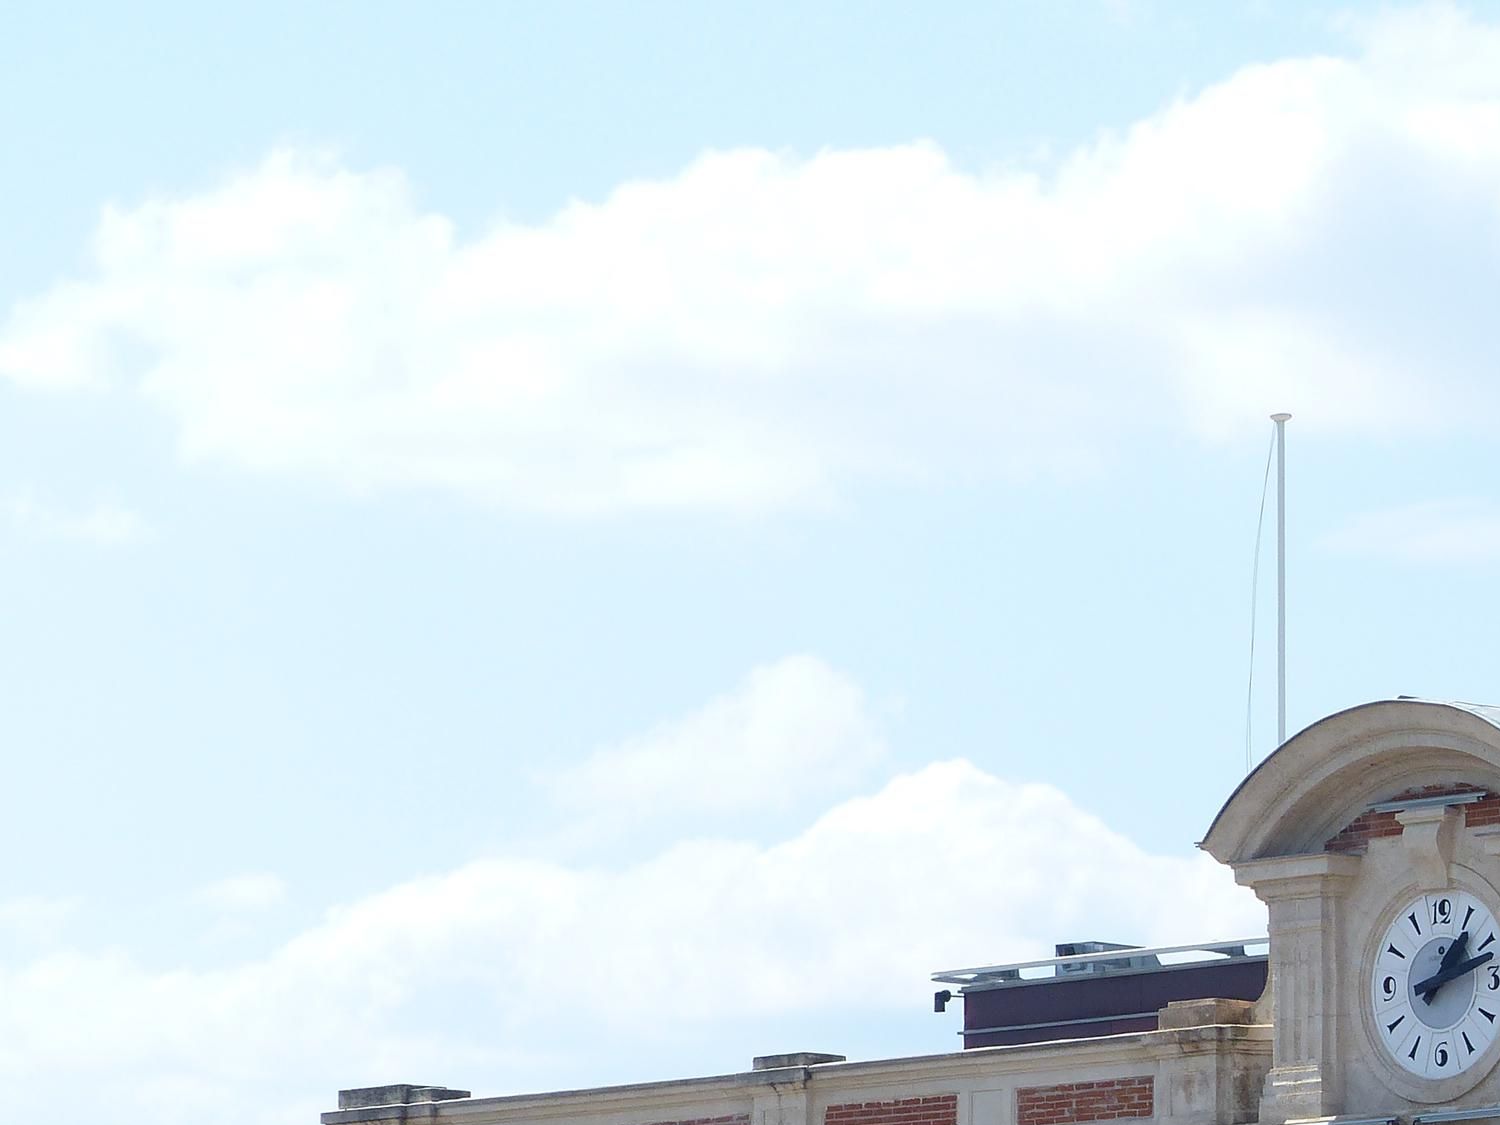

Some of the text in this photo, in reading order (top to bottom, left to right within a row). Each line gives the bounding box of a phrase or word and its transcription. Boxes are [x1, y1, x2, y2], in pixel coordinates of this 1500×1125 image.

[1432, 898, 1452, 926] 12
[1382, 976, 1397, 1002] 9
[1486, 964, 1500, 991] 3
[1434, 1041, 1449, 1068] 6
